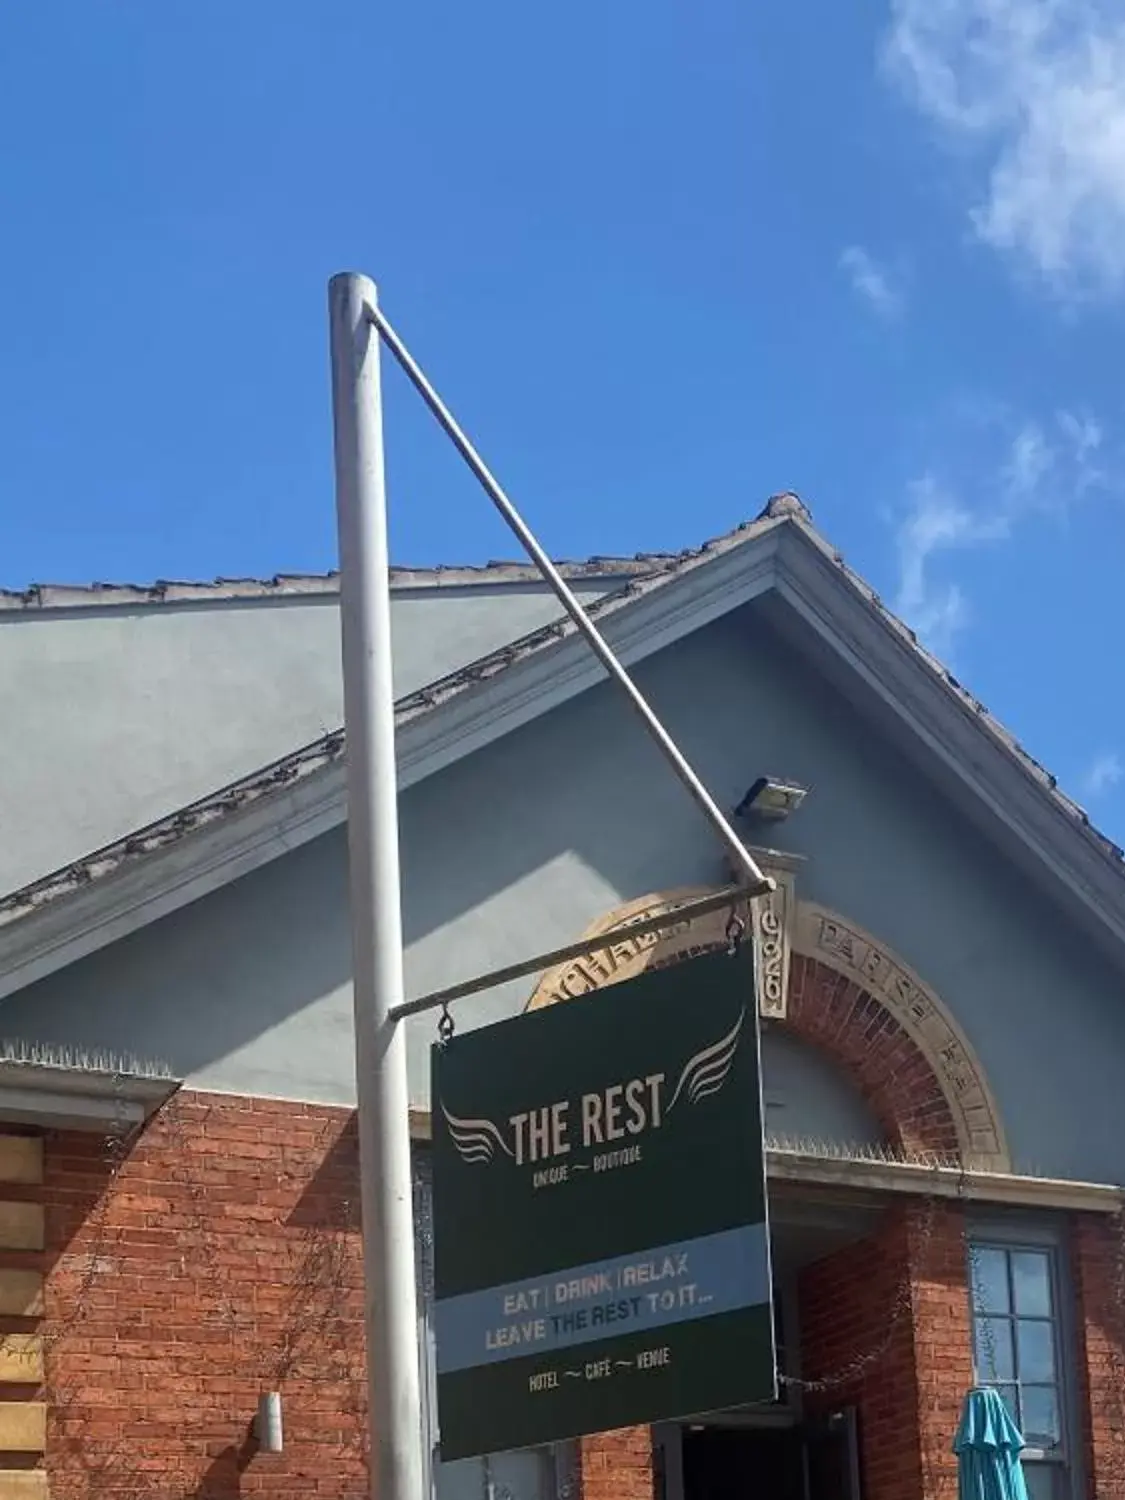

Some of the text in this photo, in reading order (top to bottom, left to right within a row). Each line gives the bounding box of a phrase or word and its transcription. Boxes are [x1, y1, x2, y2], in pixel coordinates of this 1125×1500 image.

[510, 1073, 665, 1165] THE REST
[533, 1145, 643, 1189] UNIQUE BOUTIQUE
[503, 1253, 689, 1315] EAT DRINK RELAX
[485, 1318, 546, 1350] LEAVE
[551, 1308, 588, 1335] THE
[591, 1297, 642, 1326] REST
[529, 1371, 560, 1392] HOTEL
[636, 1347, 670, 1370] VENUE
